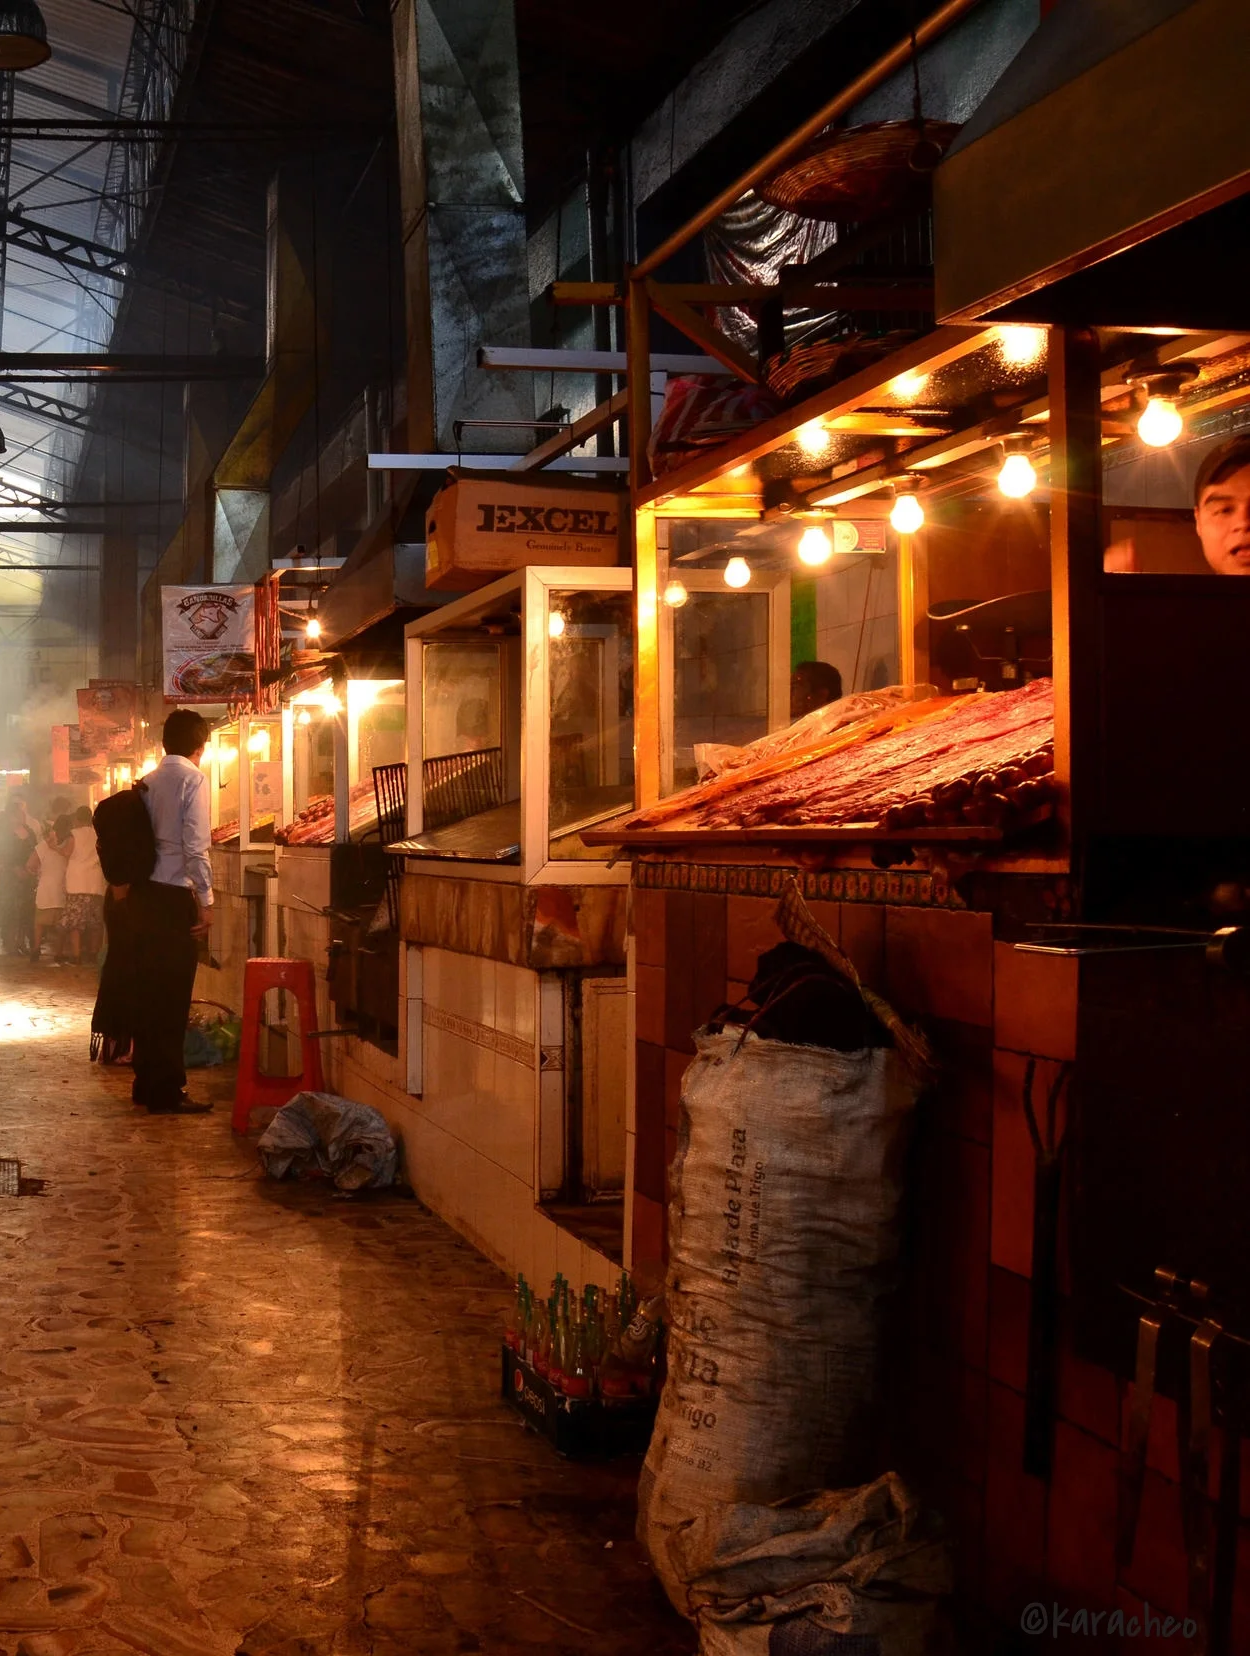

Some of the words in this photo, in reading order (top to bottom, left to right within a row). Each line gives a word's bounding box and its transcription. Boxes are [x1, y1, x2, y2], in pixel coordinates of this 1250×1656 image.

[476, 504, 617, 535] EXCEL
[526, 539, 572, 553] Genuinely
[575, 541, 602, 554] Better
[724, 1127, 747, 1194] Plata
[748, 1161, 765, 1198] Trigo
[722, 1199, 742, 1229] de
[748, 1201, 761, 1219] de
[720, 1236, 742, 1288] Hoja
[697, 1458, 713, 1472] B2
